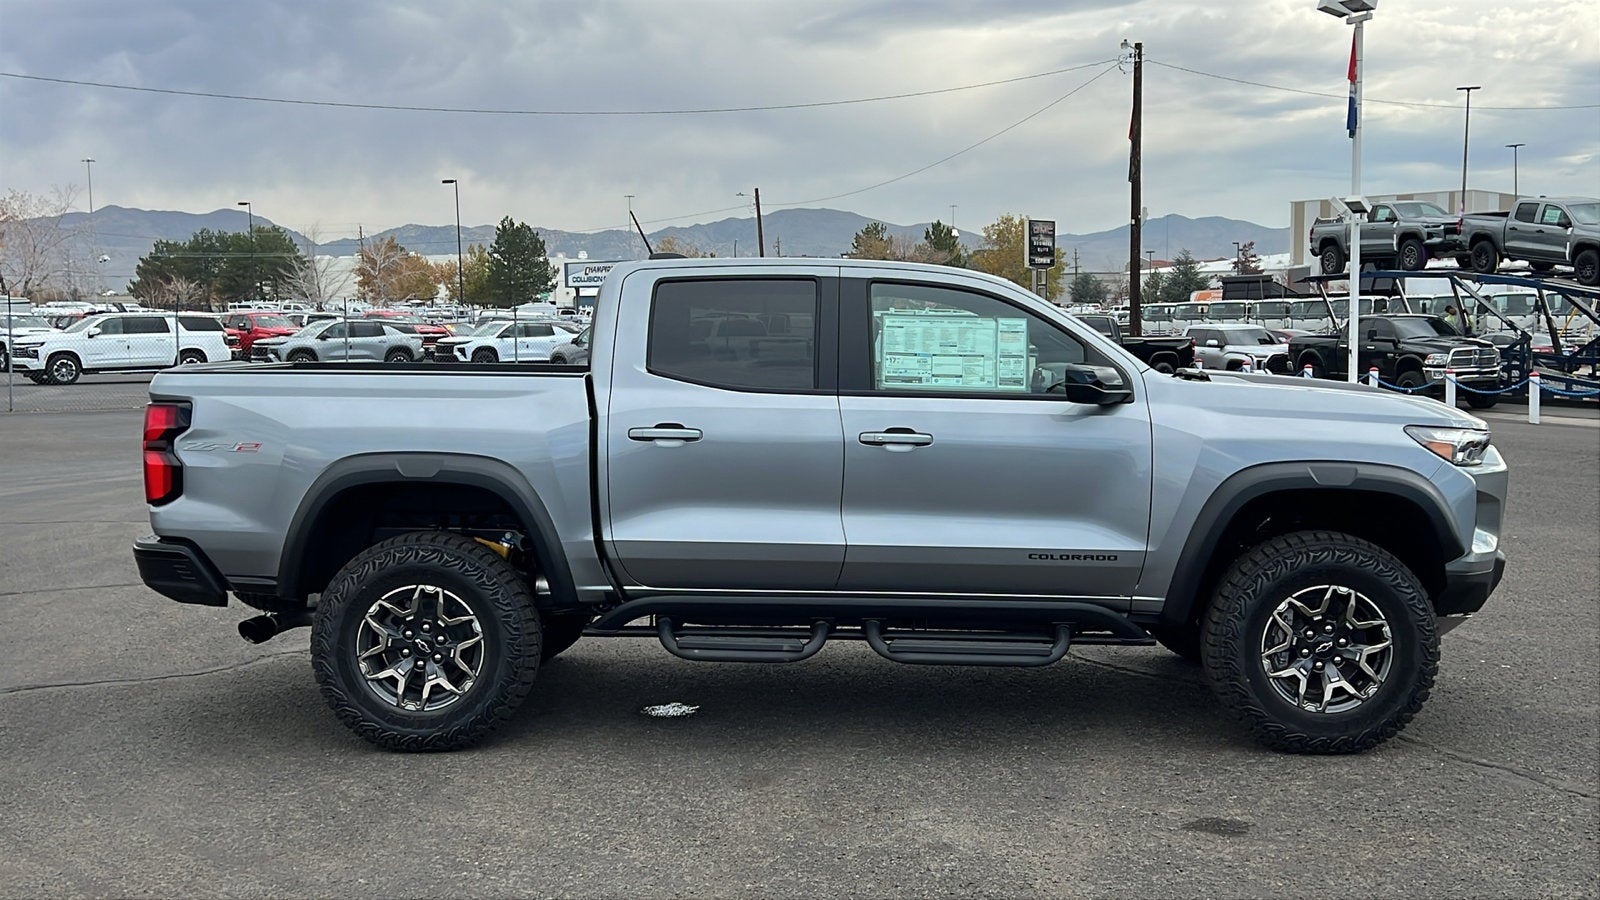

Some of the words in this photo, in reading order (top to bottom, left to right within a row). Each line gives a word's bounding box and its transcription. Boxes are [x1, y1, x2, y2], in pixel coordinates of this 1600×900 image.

[584, 266, 613, 275] CHAMPIO
[183, 442, 262, 453] ZR2
[1028, 553, 1118, 561] COLORADO
